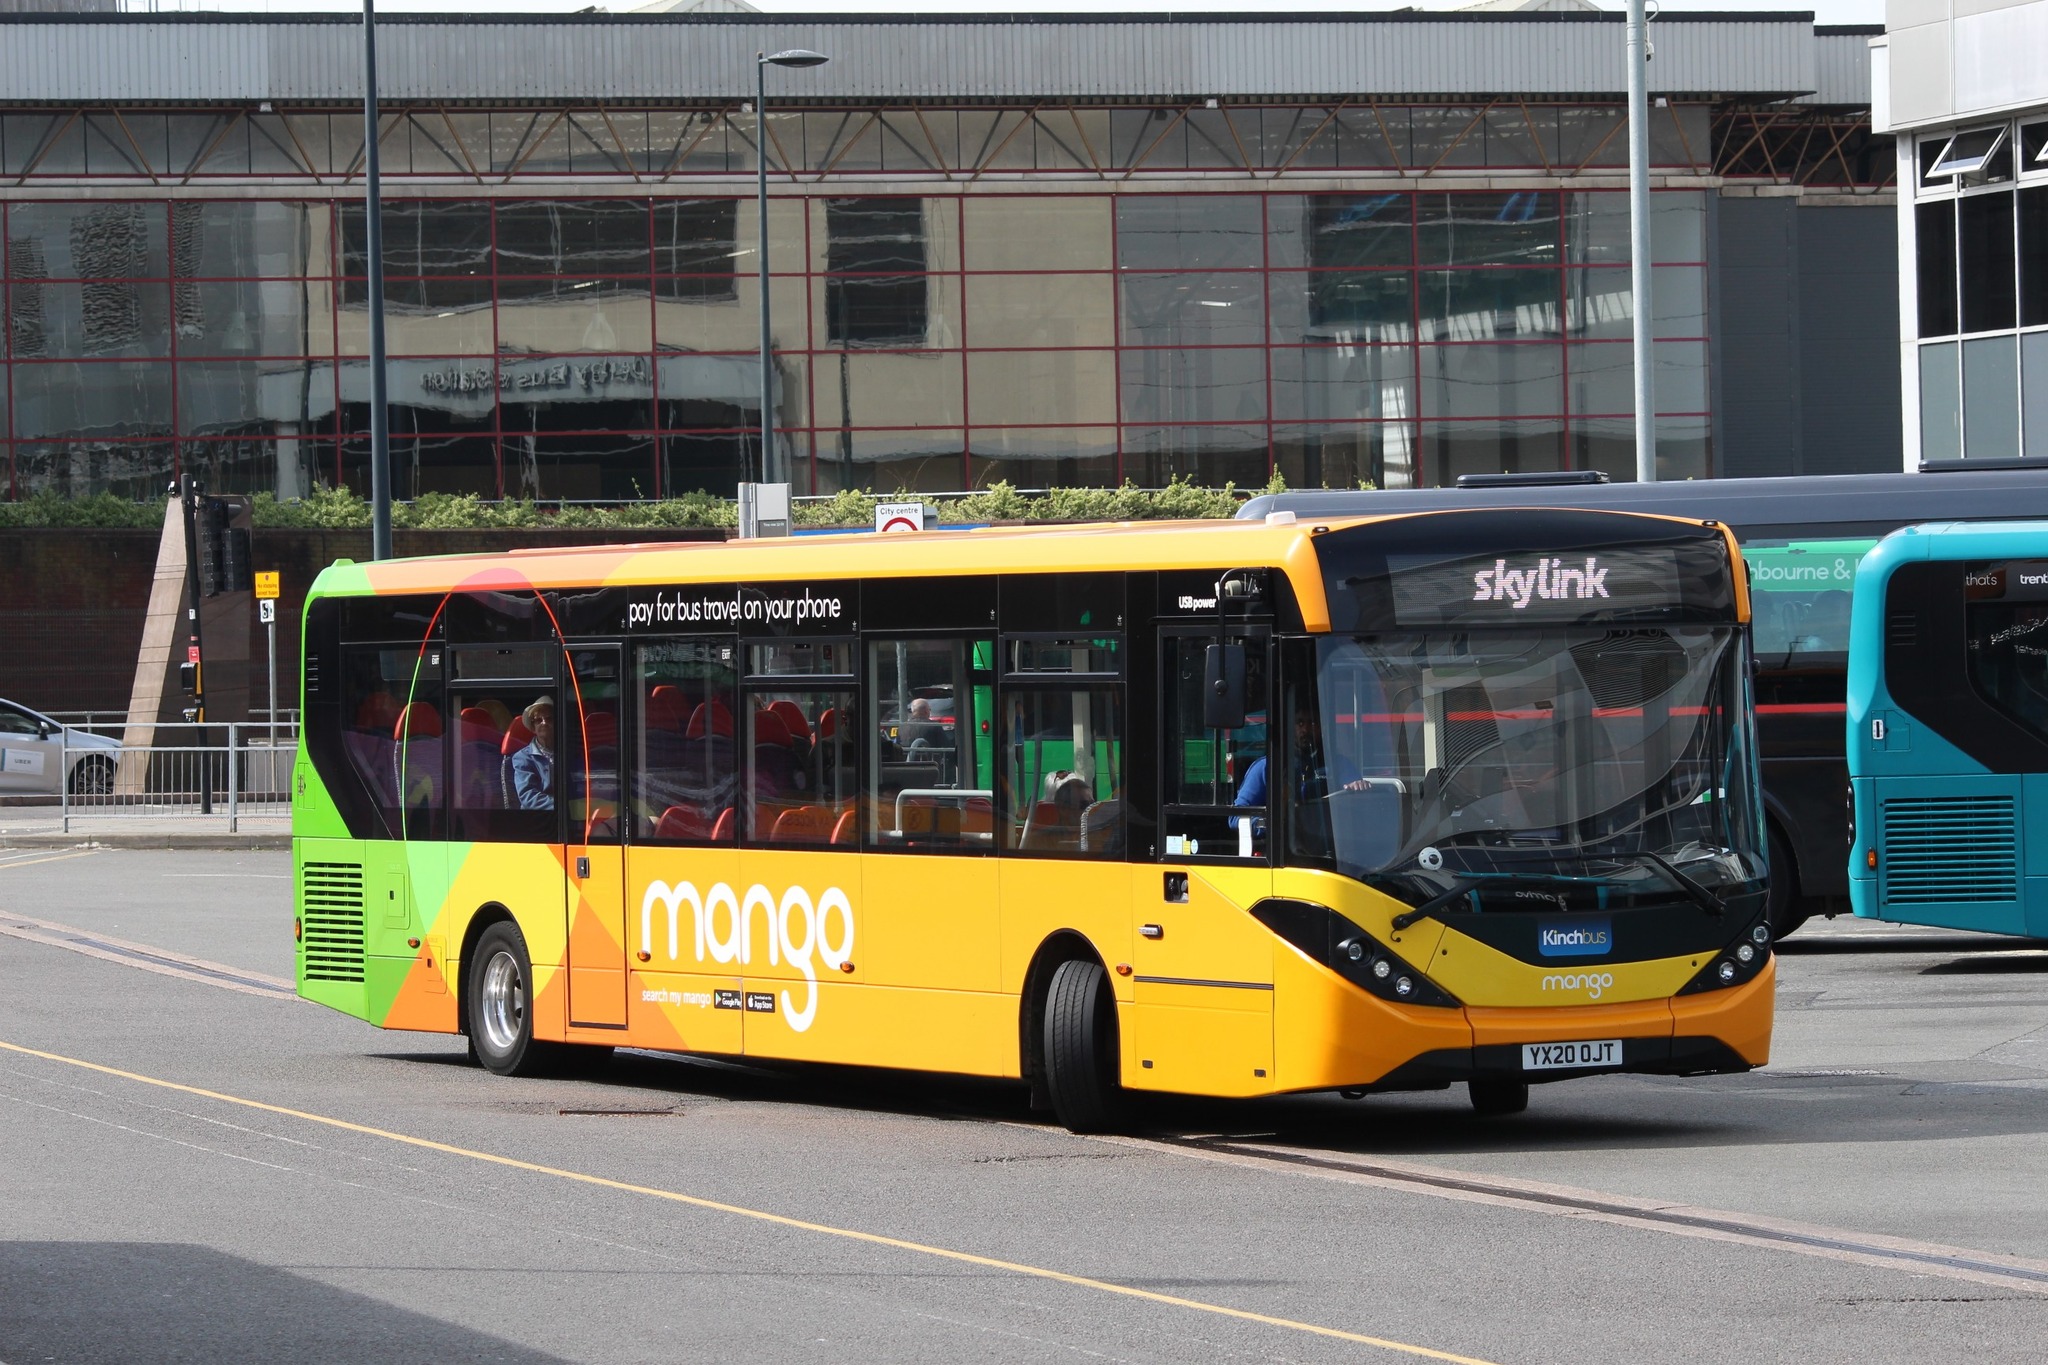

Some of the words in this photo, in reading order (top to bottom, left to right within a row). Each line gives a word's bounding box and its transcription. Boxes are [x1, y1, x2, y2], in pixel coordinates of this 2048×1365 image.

[880, 507, 894, 516] City
[896, 507, 919, 515] centre
[1833, 558, 1851, 581] &
[1965, 572, 1998, 586] that's
[1473, 557, 1610, 609] skylink
[629, 603, 654, 628] pay
[657, 592, 675, 621] for
[677, 591, 701, 621] bus
[703, 590, 743, 620] travel
[744, 600, 762, 620] on
[765, 599, 795, 624] your
[796, 588, 841, 625] phone
[1178, 596, 1193, 609] USB
[1193, 598, 1217, 612] power
[1543, 928, 1607, 946] Kinchbus
[641, 879, 855, 1033] mango
[1542, 972, 1614, 999] mango
[642, 988, 667, 1002] search
[669, 991, 683, 1007] my
[684, 993, 711, 1008] mango
[754, 1000, 763, 1011] App
[762, 1001, 773, 1010] Store
[1530, 1044, 1576, 1066] YX20
[1580, 1043, 1614, 1063] OJT
